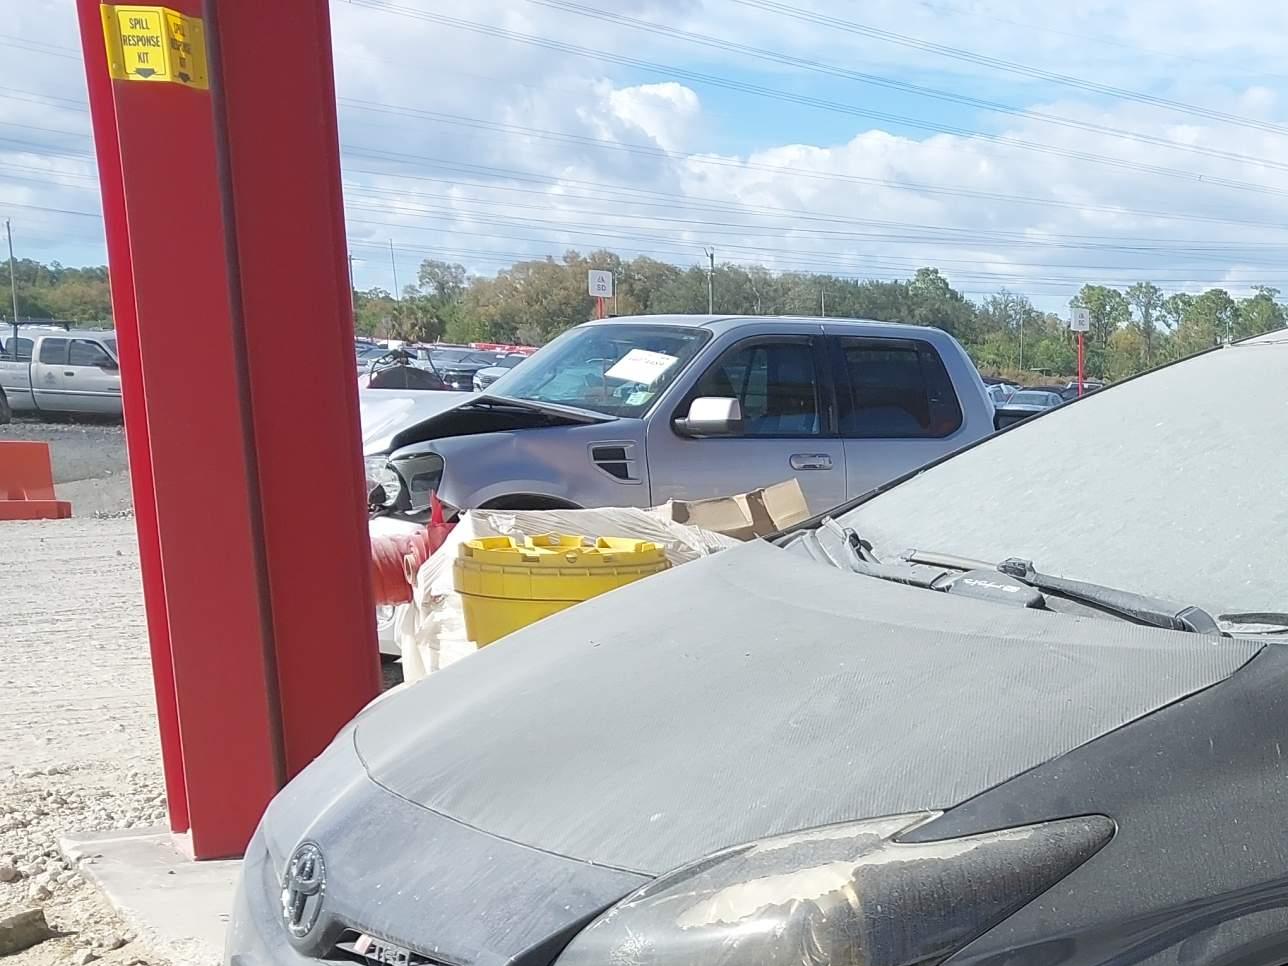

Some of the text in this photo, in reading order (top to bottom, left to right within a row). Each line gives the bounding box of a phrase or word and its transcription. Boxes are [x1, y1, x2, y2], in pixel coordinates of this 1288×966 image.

[128, 17, 151, 30] SPILL
[121, 34, 161, 48] RESPONSE
[138, 52, 149, 64] KIT
